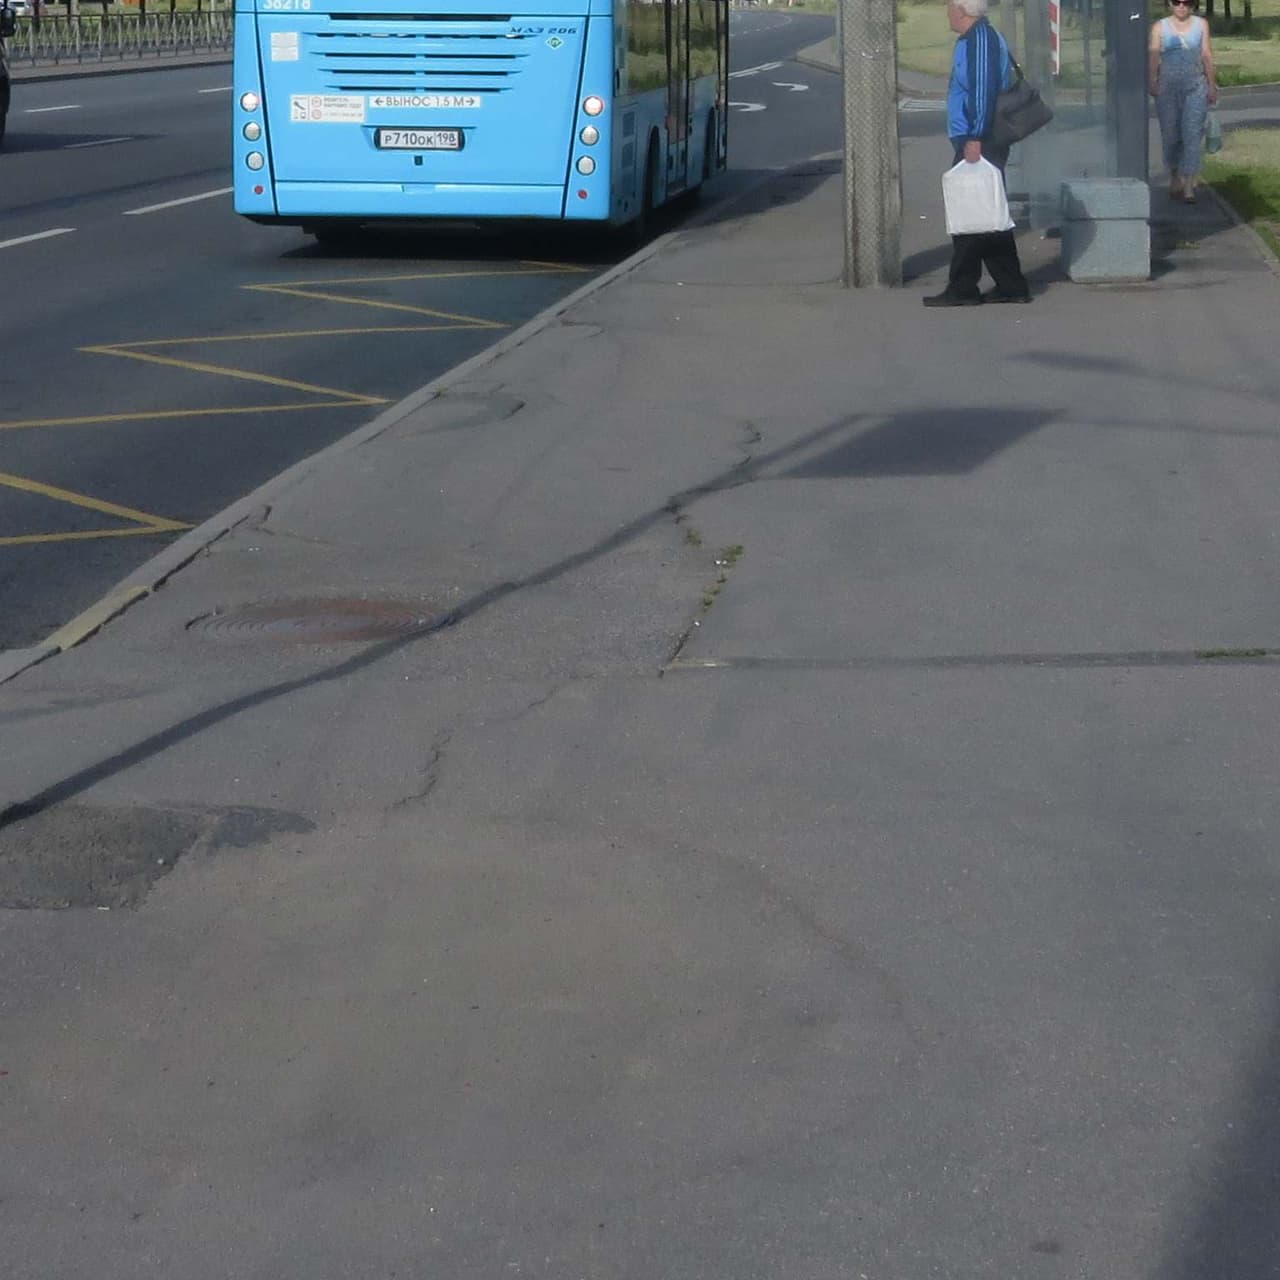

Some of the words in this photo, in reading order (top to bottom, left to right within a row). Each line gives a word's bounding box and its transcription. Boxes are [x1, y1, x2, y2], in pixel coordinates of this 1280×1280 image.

[386, 96, 431, 107] ВЫНОС
[454, 97, 464, 106] М
[384, 132, 433, 145] Р710ОК
